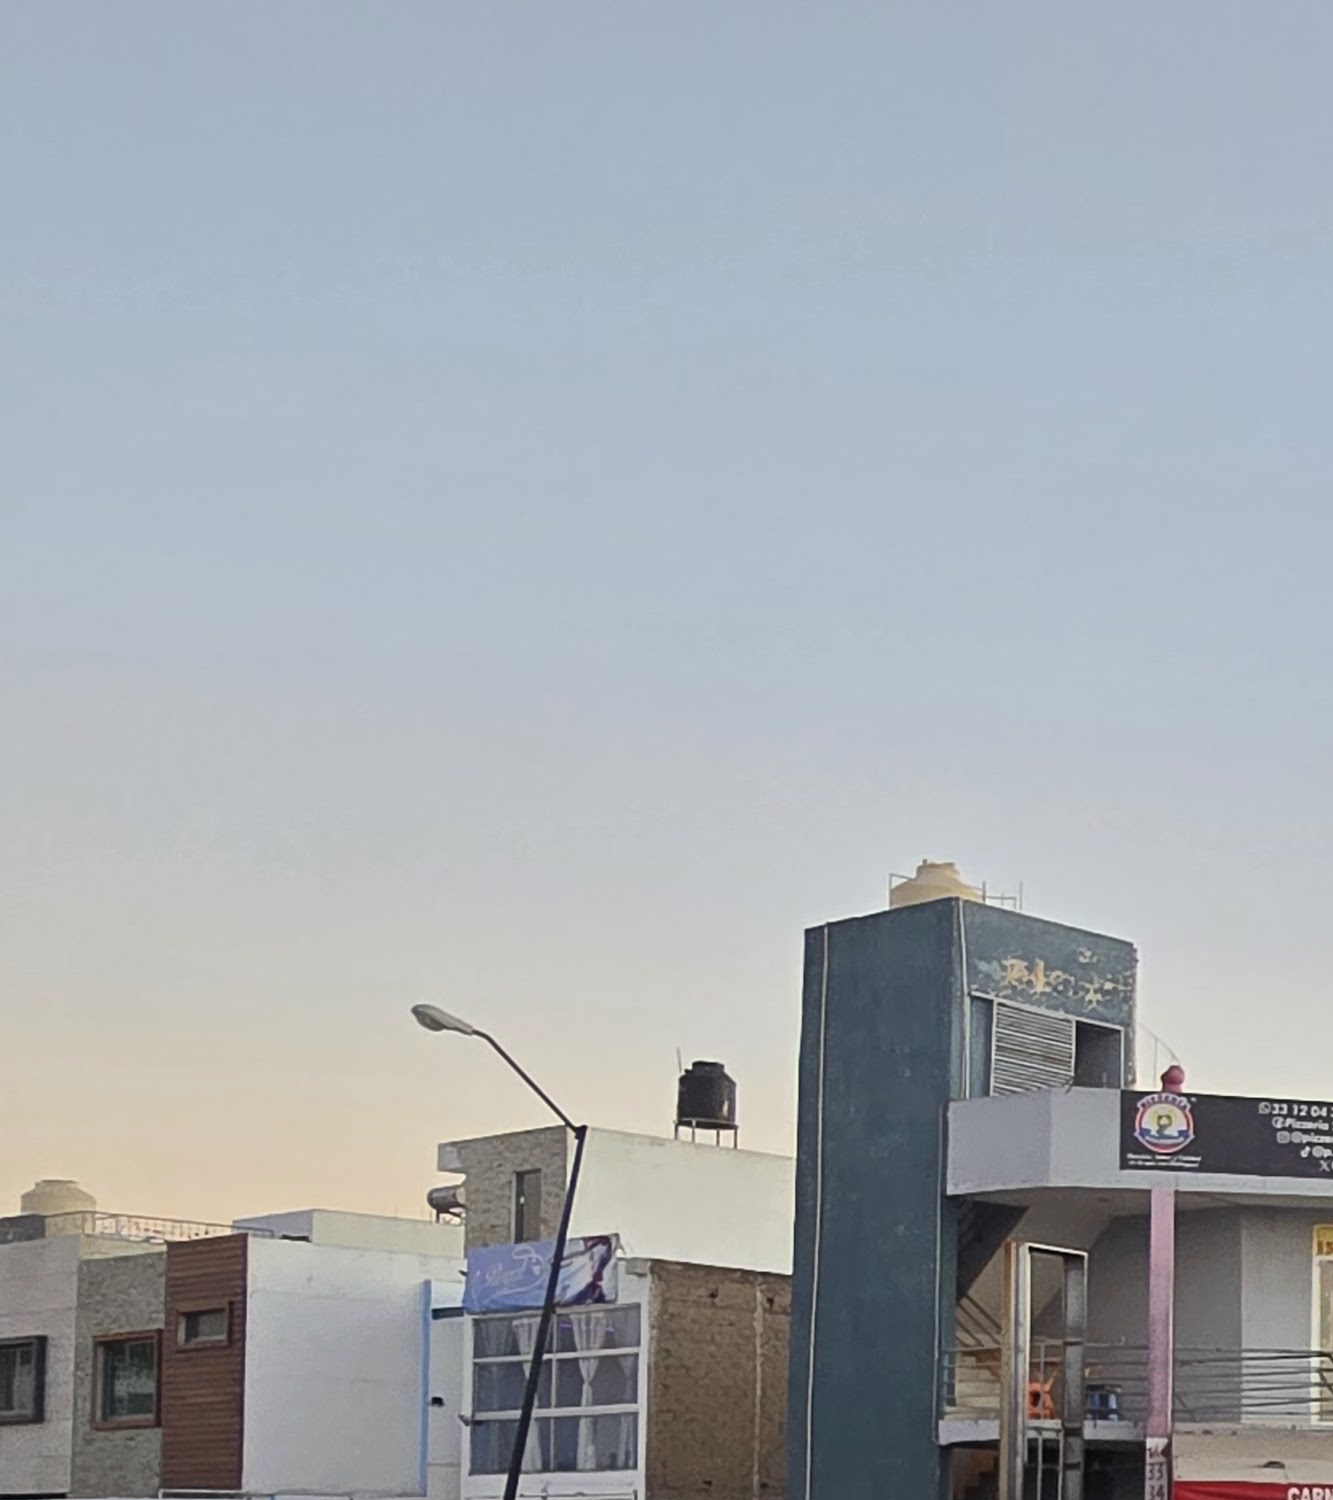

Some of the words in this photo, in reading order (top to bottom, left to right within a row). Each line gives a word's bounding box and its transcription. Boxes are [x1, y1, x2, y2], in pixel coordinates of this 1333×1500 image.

[1272, 1104, 1288, 1115] 33
[1292, 1104, 1307, 1116] 12
[1311, 1105, 1327, 1117] 04
